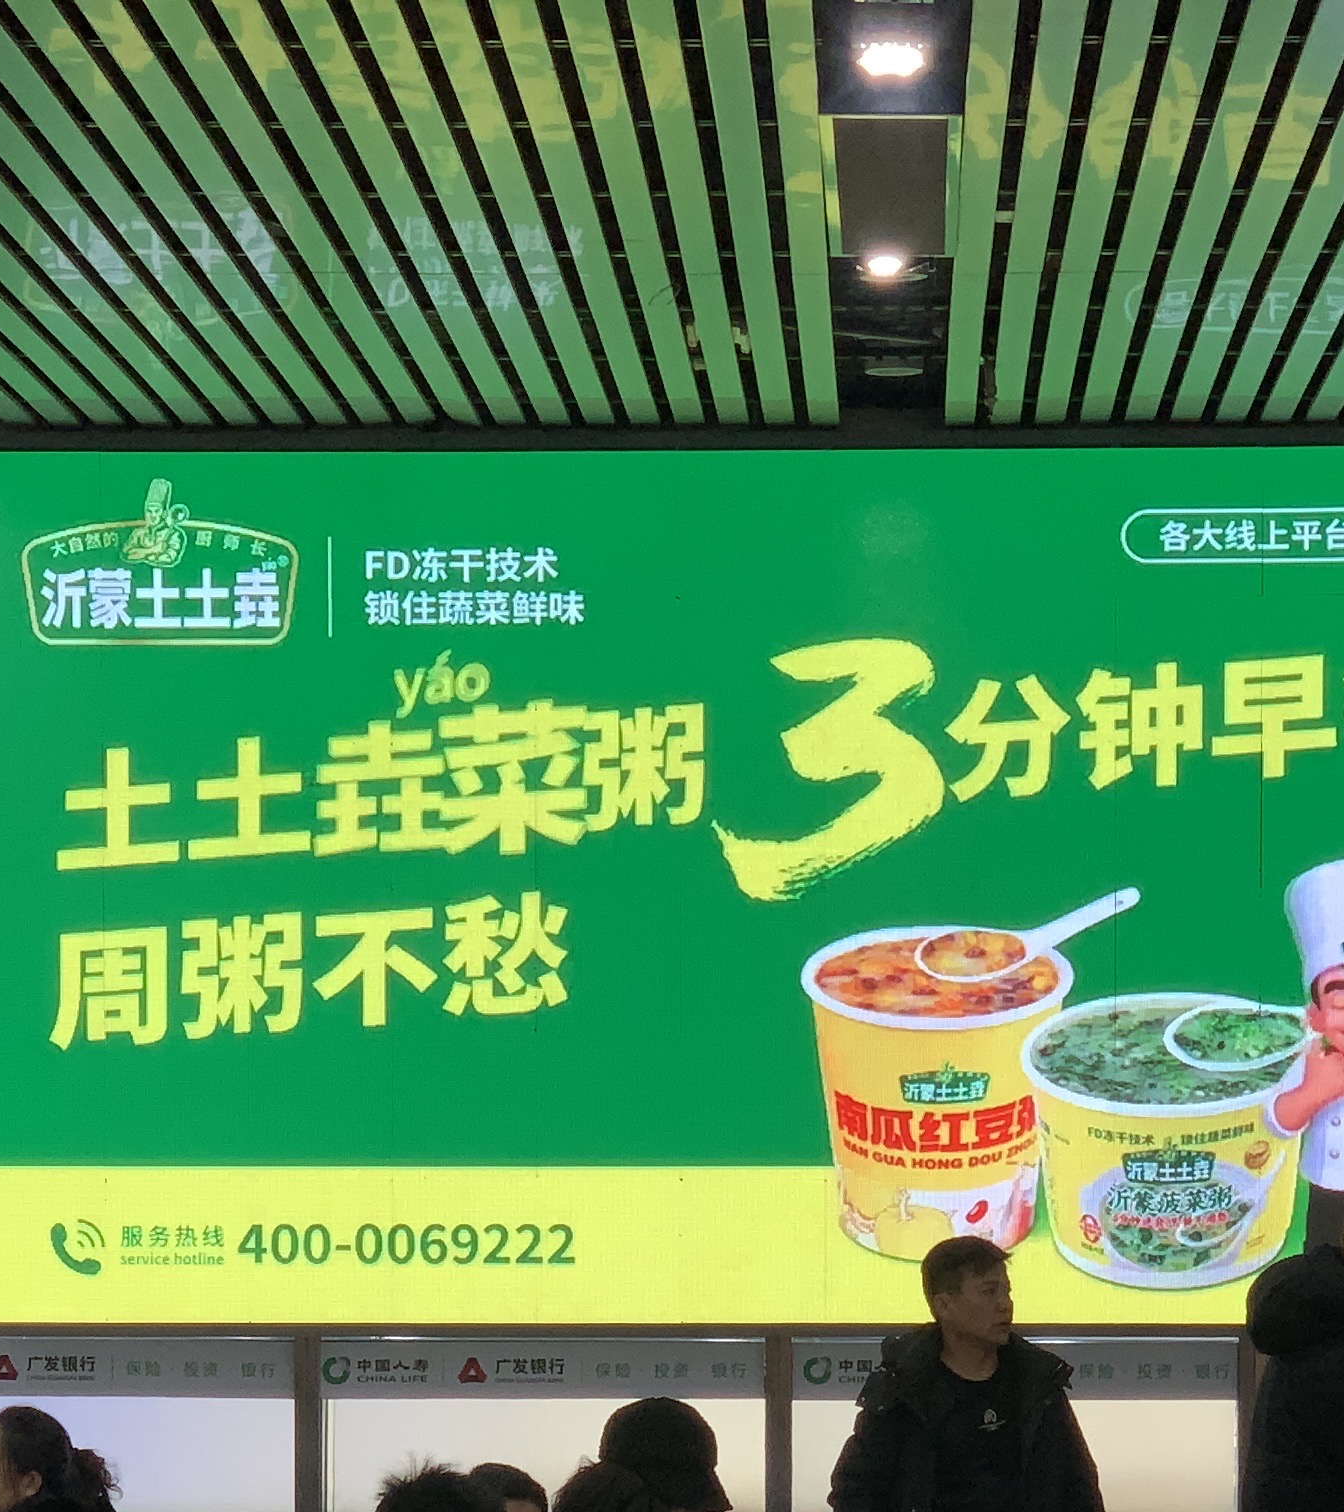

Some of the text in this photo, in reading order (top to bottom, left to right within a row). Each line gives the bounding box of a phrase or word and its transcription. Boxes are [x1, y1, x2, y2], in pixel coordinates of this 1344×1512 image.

[50, 530, 119, 559] 大自然的
[364, 547, 559, 583] FD冻干技术
[40, 567, 282, 629] 沂蒙土土垚
[364, 590, 586, 626] 锁住蔬菜鲜味
[393, 649, 491, 718] yáo
[57, 698, 704, 871] 土土垚菜粥
[49, 891, 568, 1050] 周粥不愁
[872, 1152, 906, 1168] GUA
[911, 1157, 963, 1170] HONG
[968, 1151, 1003, 1167] DOU
[120, 1224, 225, 1249] 服务热线
[238, 1223, 576, 1265] 400-0069222
[120, 1251, 225, 1266] service hotline
[26, 1356, 96, 1372] 广发银行
[357, 1358, 429, 1373] 中国人寿
[357, 1374, 428, 1383] CHINA LIFE
[494, 1357, 565, 1375] 广发银行
